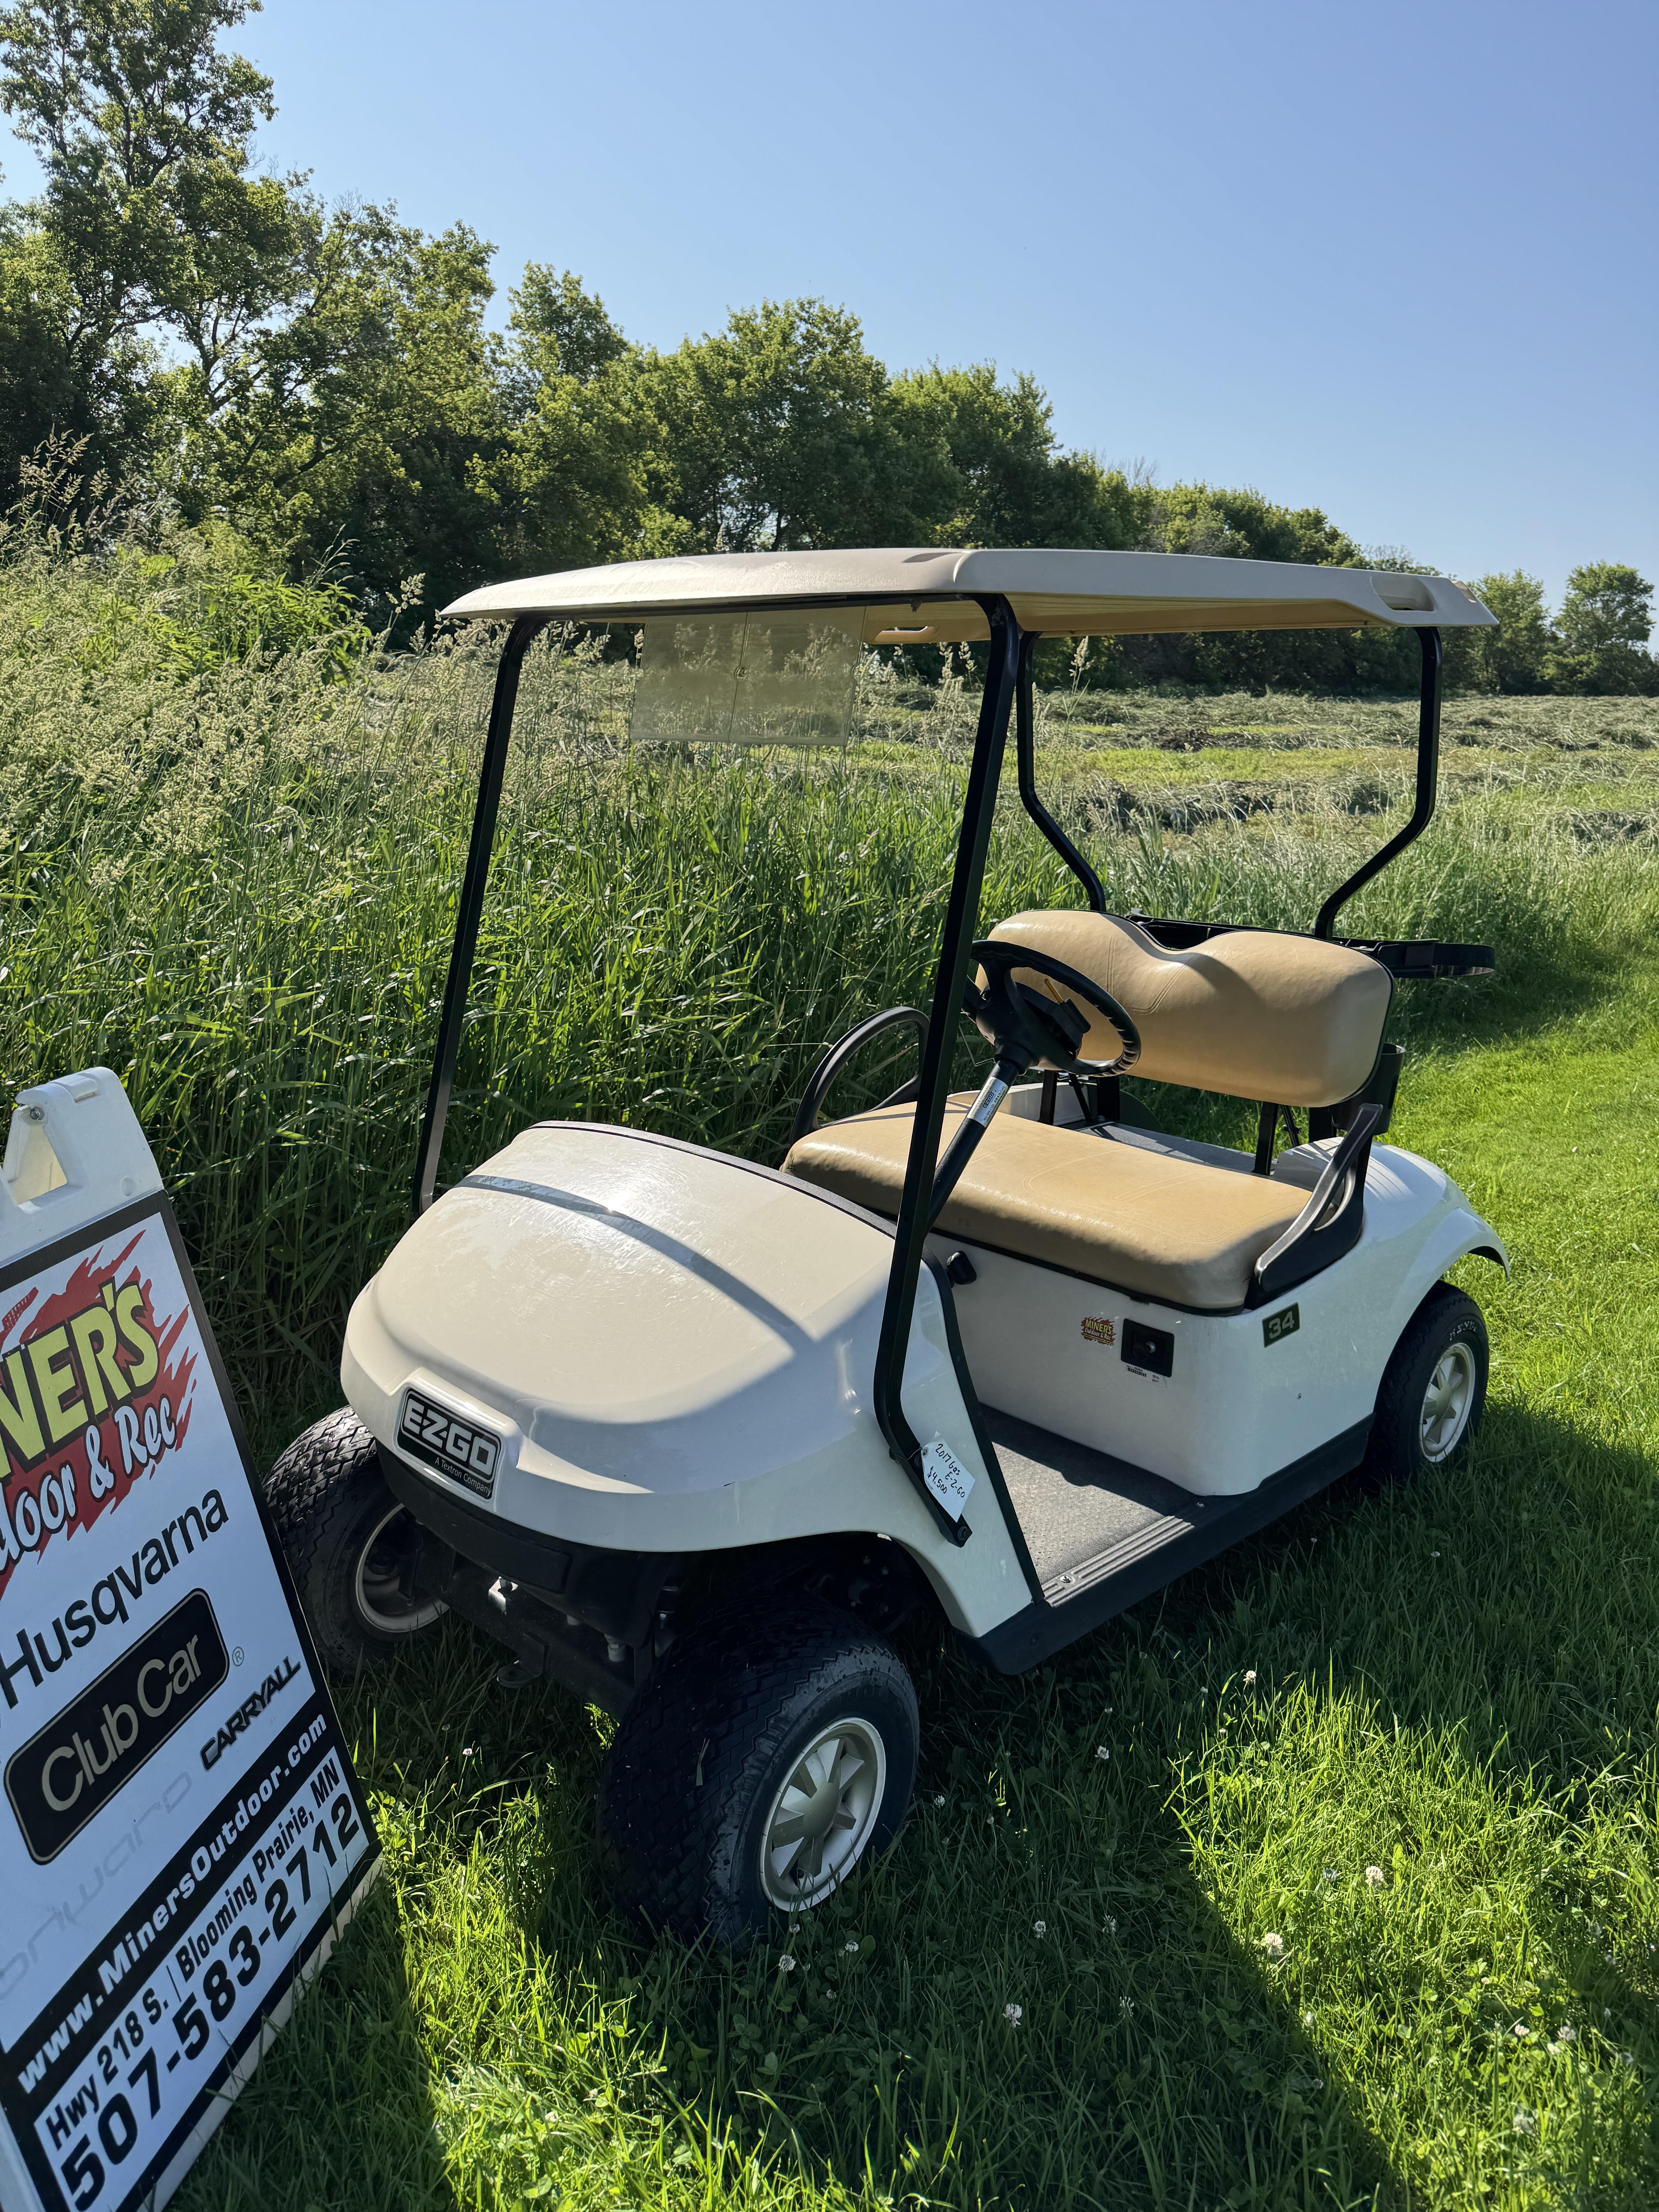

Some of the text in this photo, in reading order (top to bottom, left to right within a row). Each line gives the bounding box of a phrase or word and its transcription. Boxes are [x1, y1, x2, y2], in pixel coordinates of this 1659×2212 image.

[1085, 1319, 1112, 1335] MINER'S
[1269, 1310, 1295, 1339] 34
[86, 1425, 114, 1499] &
[114, 1396, 176, 1474] Rec
[435, 1457, 492, 1497] A Textron Company
[935, 1443, 960, 1475] 2017 Gas
[0, 1489, 230, 1709] Husqvarna
[42, 1634, 201, 1811] Club Car
[200, 1655, 301, 1772] CARRYALL
[17, 1713, 327, 2094] www.MinersOutdoor.com
[45, 2074, 100, 2151] Hwy
[97, 2010, 144, 2086] 218
[143, 1987, 169, 2025] S.
[175, 1873, 257, 1983] Blooming
[252, 1805, 314, 1883] Prairie,
[310, 1757, 340, 1809] MN
[61, 1793, 360, 2212] 507-583-2712
